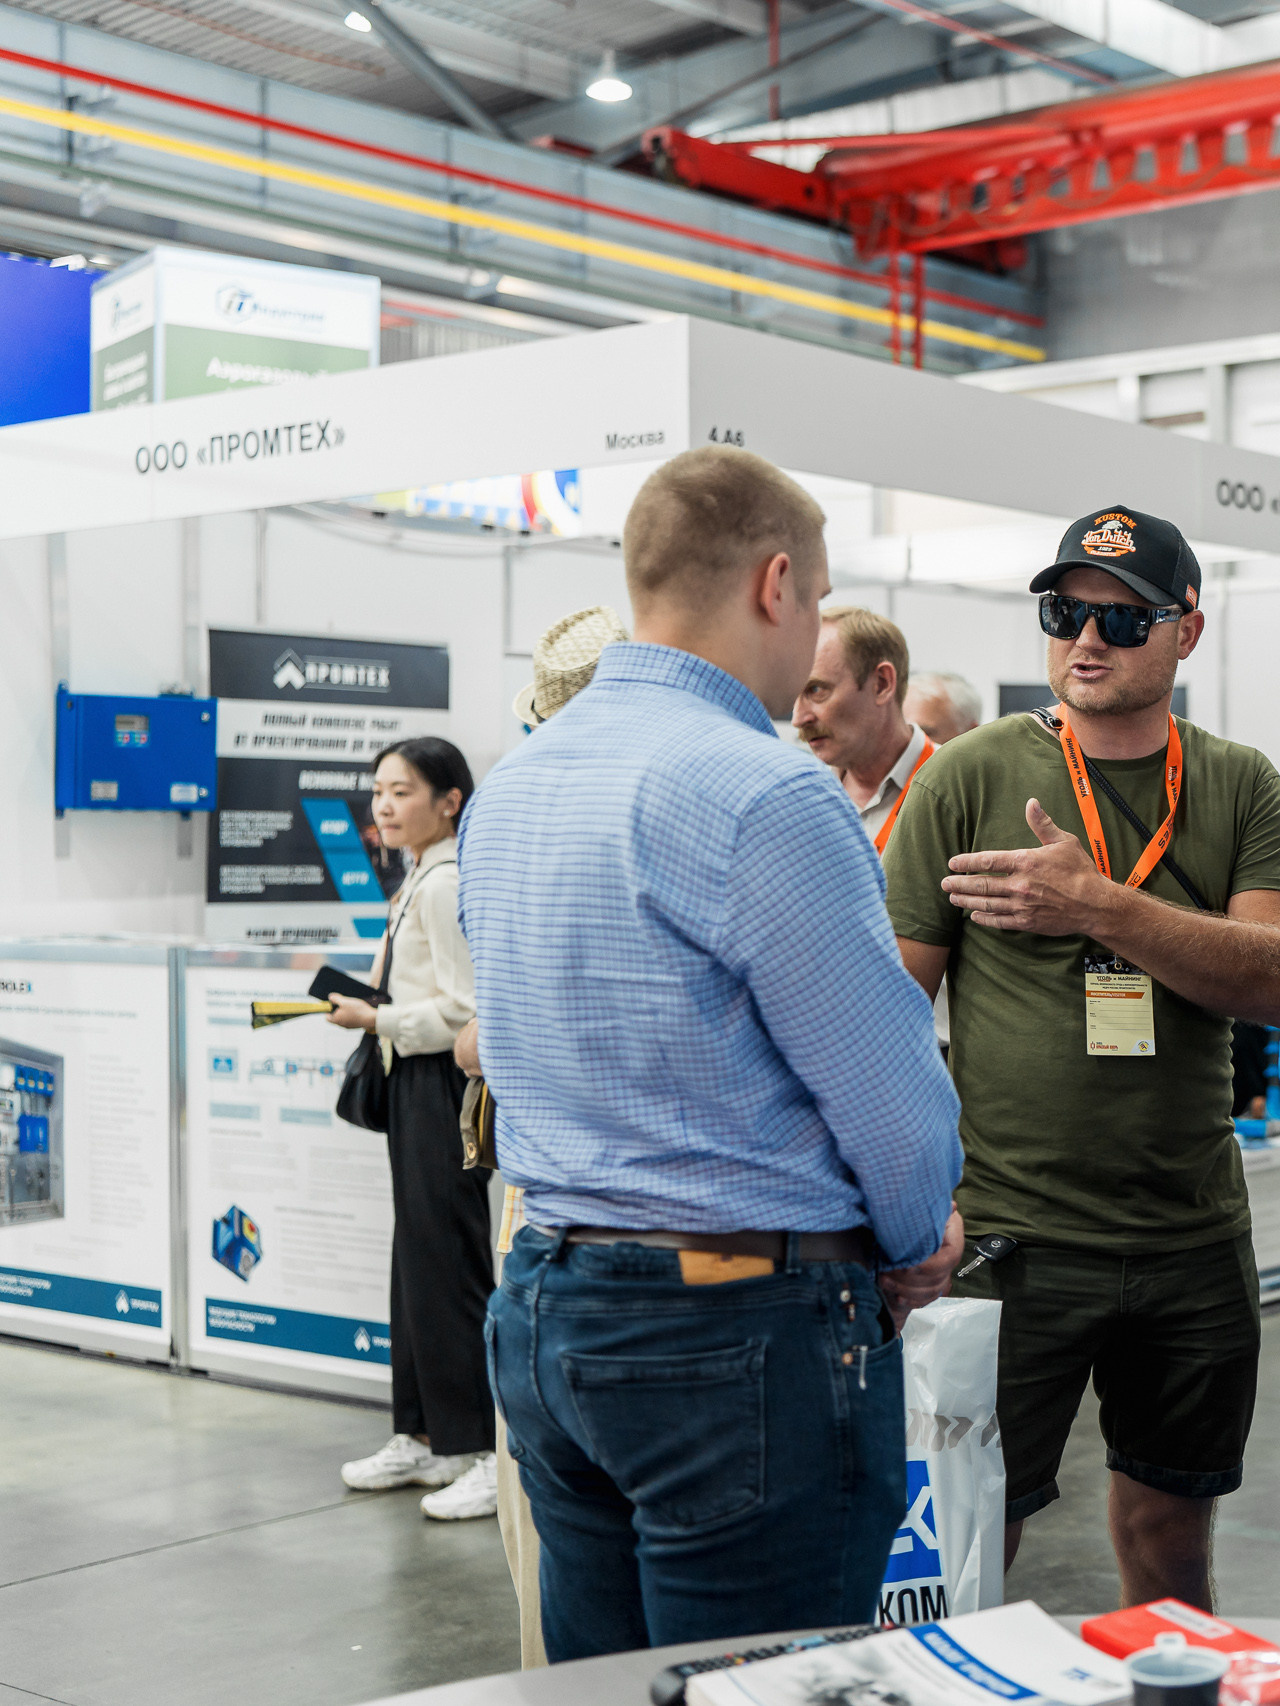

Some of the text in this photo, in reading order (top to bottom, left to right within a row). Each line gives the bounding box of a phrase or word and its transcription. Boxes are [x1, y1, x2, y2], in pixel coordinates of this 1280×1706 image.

[136, 419, 346, 474] ООО «ПРОМТЕХ»
[606, 431, 665, 449] Москва
[1216, 479, 1265, 512] ООО
[1094, 513, 1137, 529] KUSTOM
[878, 1584, 948, 1629] КОМ
